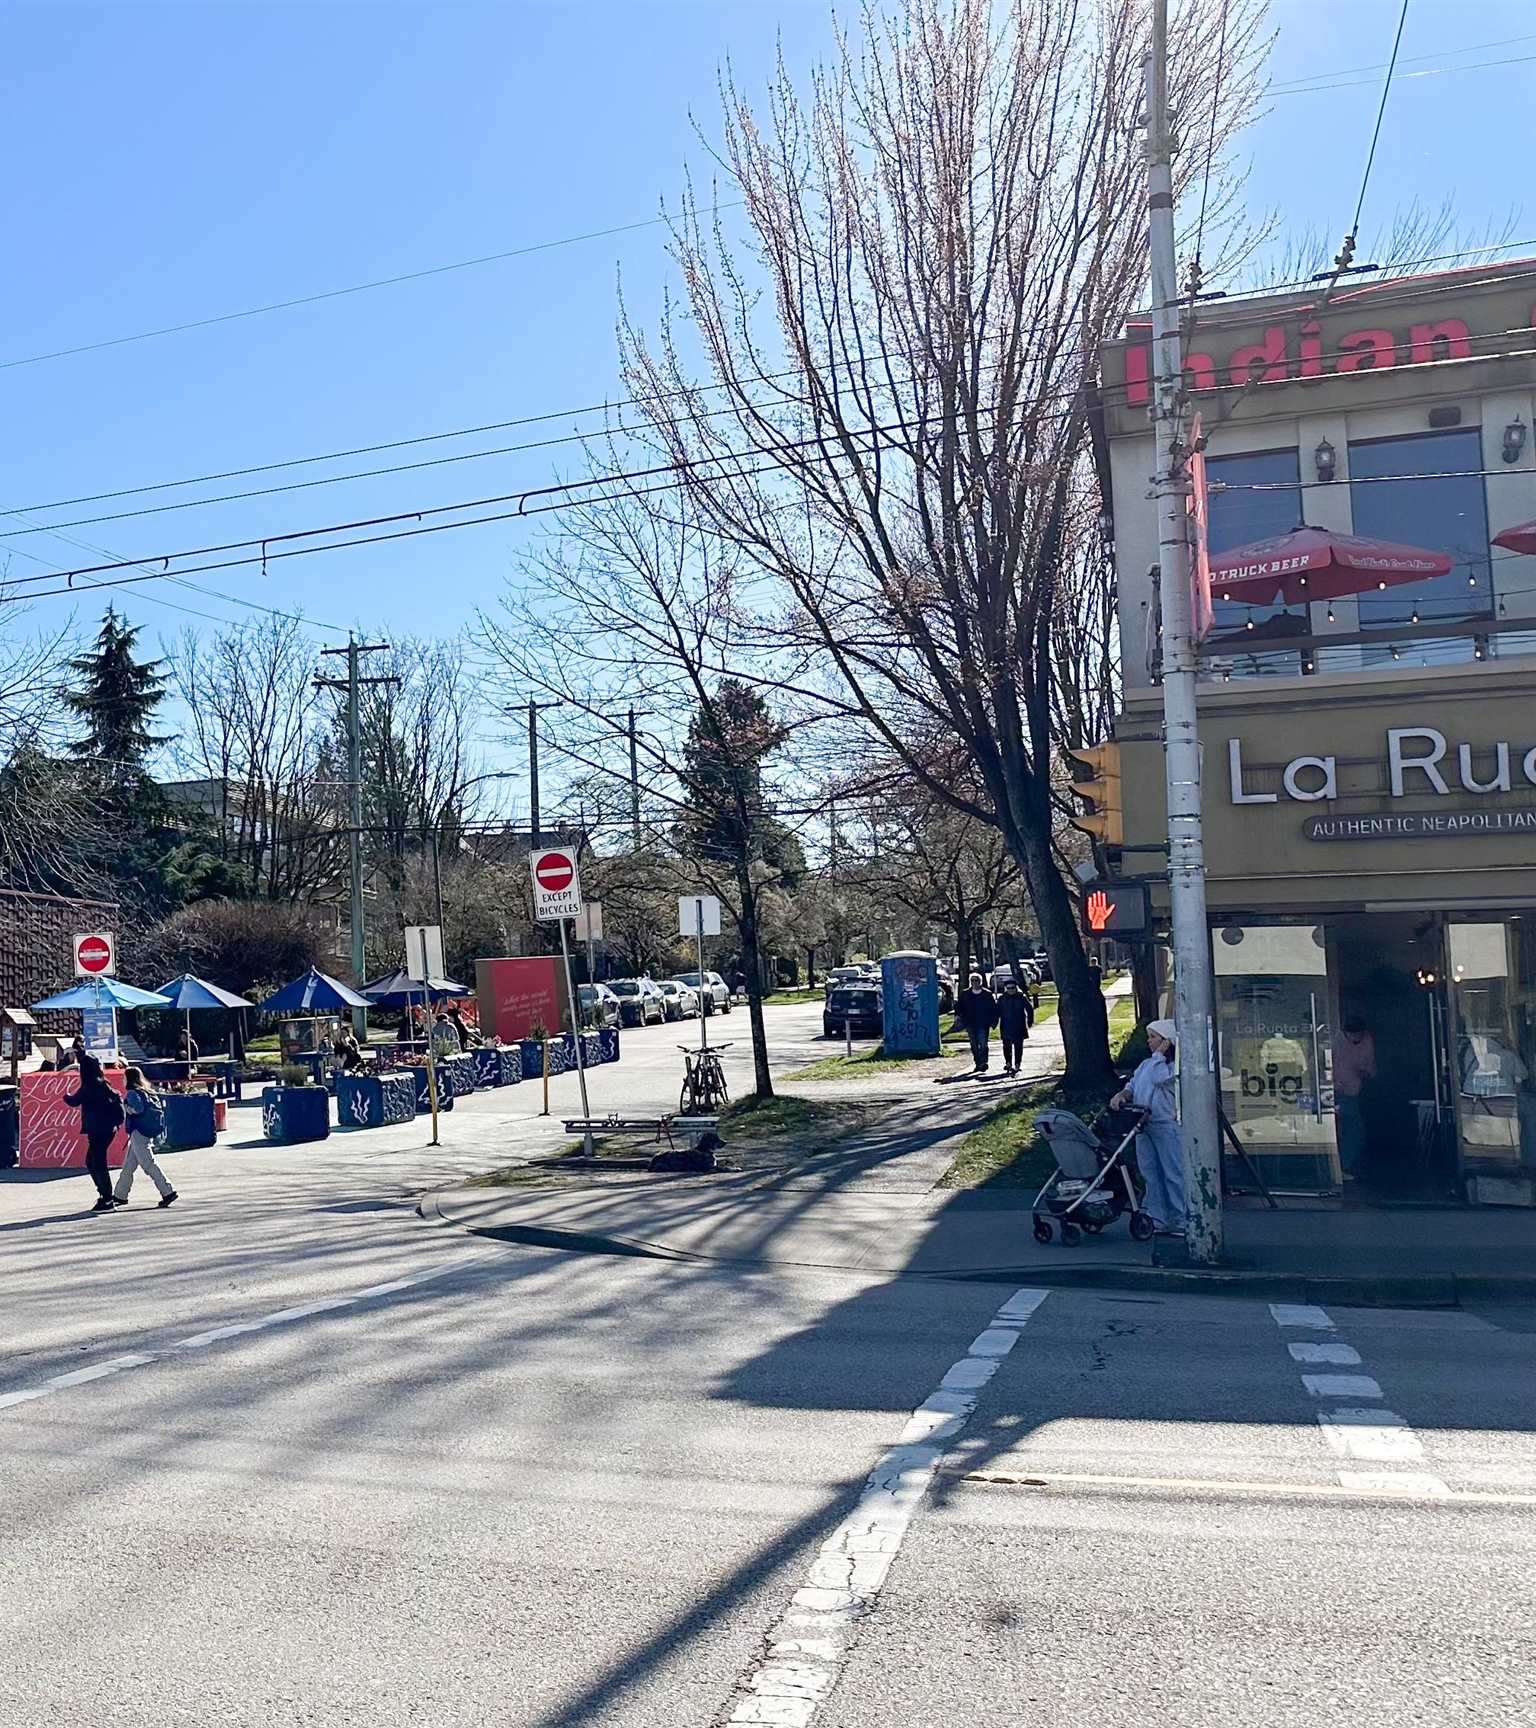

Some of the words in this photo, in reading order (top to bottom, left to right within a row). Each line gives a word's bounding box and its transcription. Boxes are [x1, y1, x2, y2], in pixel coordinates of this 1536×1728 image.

[1125, 318, 1472, 408] Indian
[1219, 563, 1268, 581] TRUCK
[1271, 556, 1309, 573] BEER
[1229, 738, 1338, 804] La
[1387, 727, 1536, 797] Ru
[1313, 816, 1415, 837] AUTHENTIC
[539, 903, 578, 916] BICYCLES
[542, 891, 572, 903] EXCEPT
[22, 1072, 81, 1102] Love
[1241, 1062, 1302, 1105] big
[21, 1099, 81, 1140] Your
[23, 1129, 79, 1168] City
